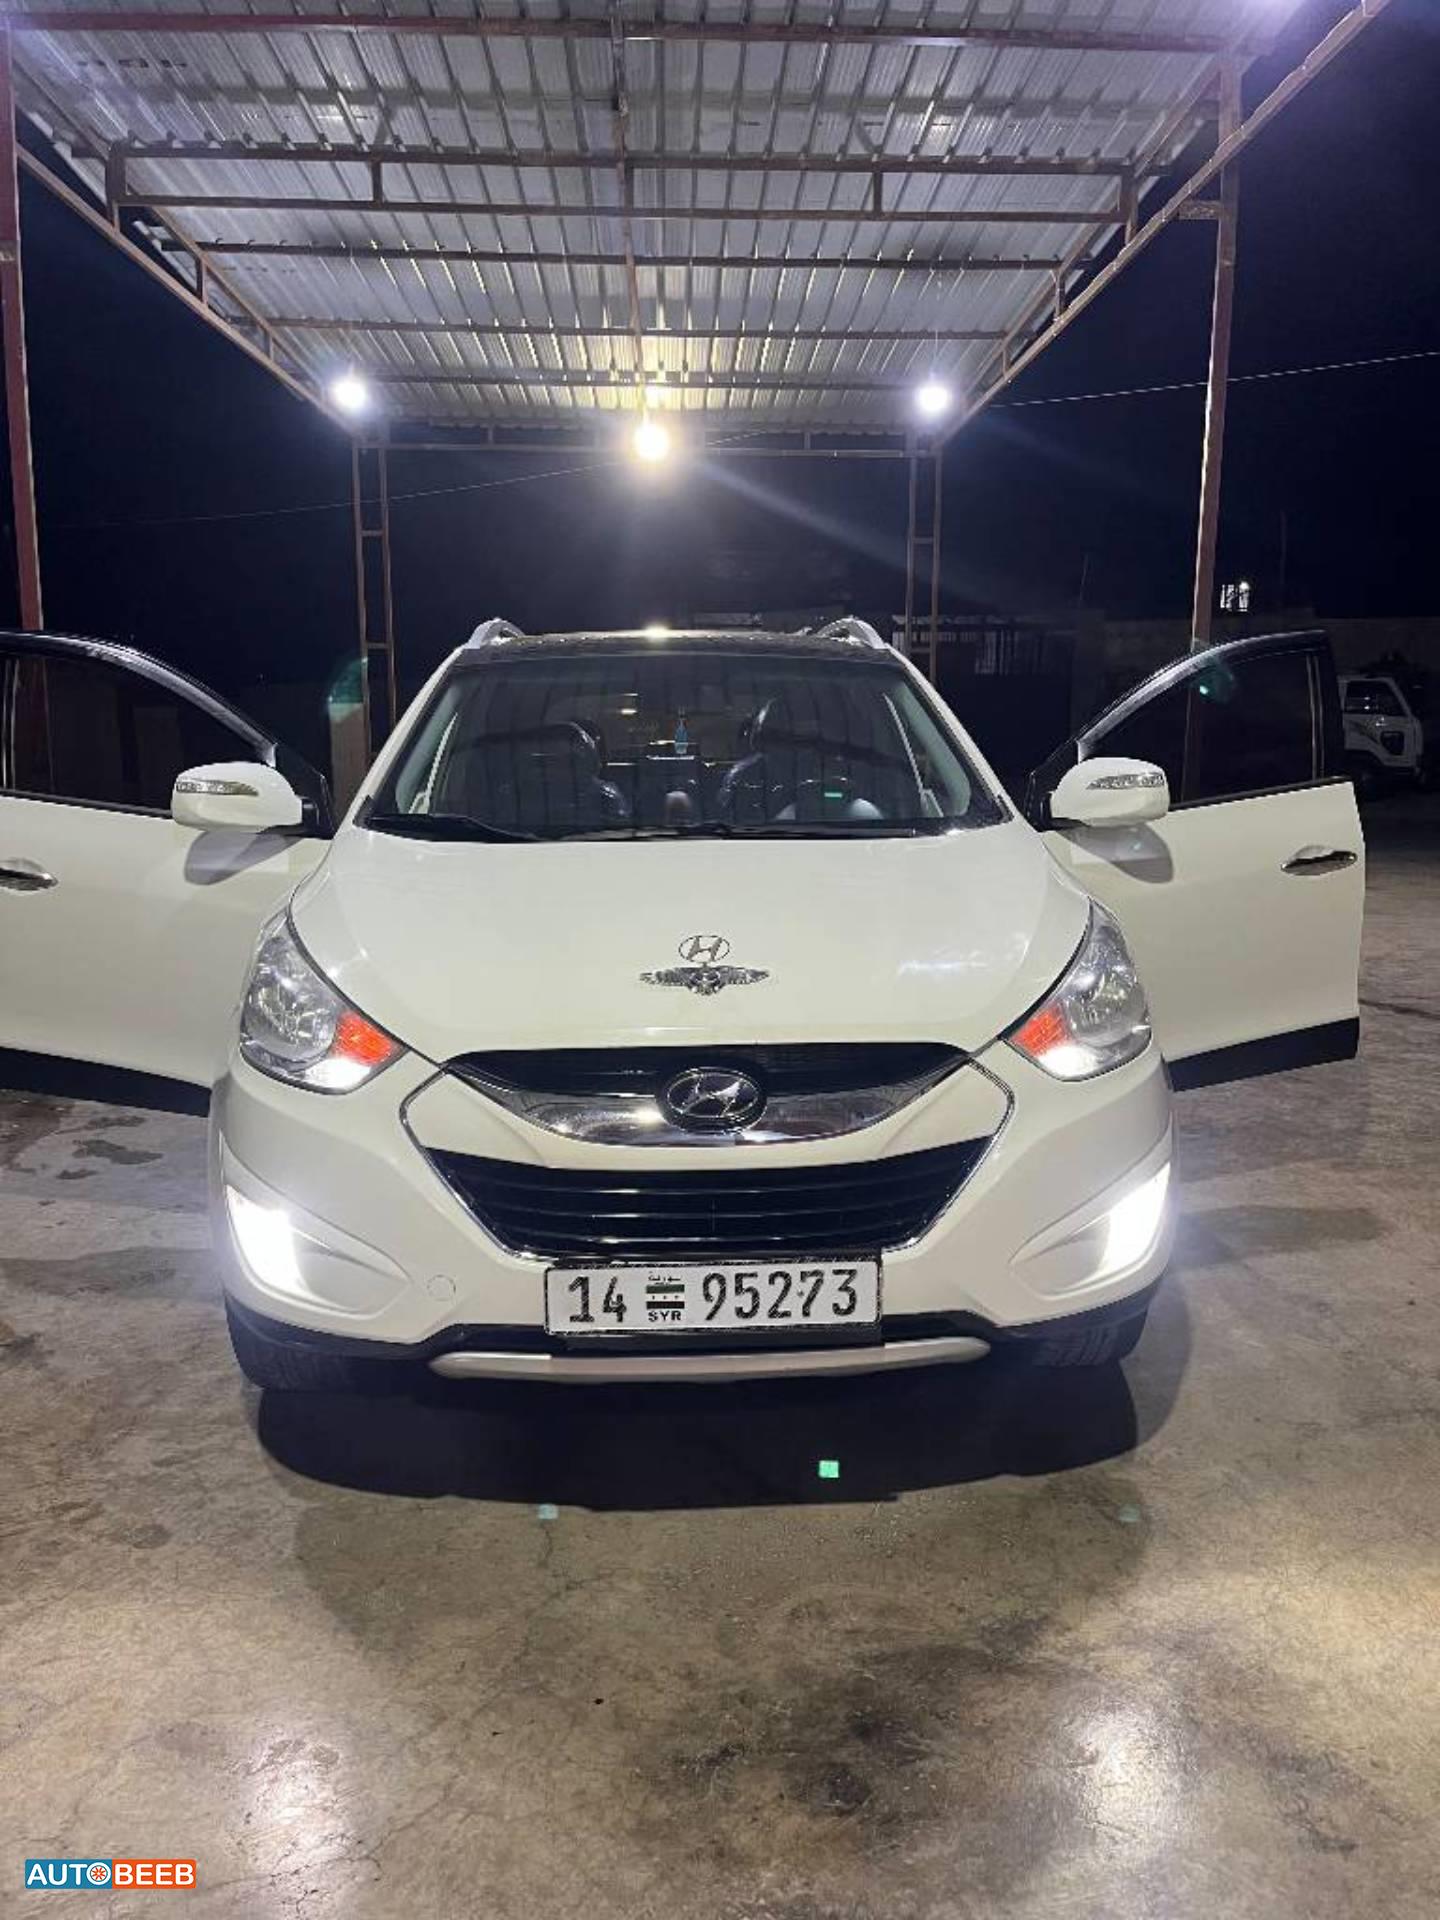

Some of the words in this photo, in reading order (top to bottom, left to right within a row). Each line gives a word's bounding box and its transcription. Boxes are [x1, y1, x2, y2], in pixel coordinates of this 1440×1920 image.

[568, 1276, 627, 1323] 14
[702, 1269, 857, 1321] 95273
[648, 1310, 682, 1322] SYR
